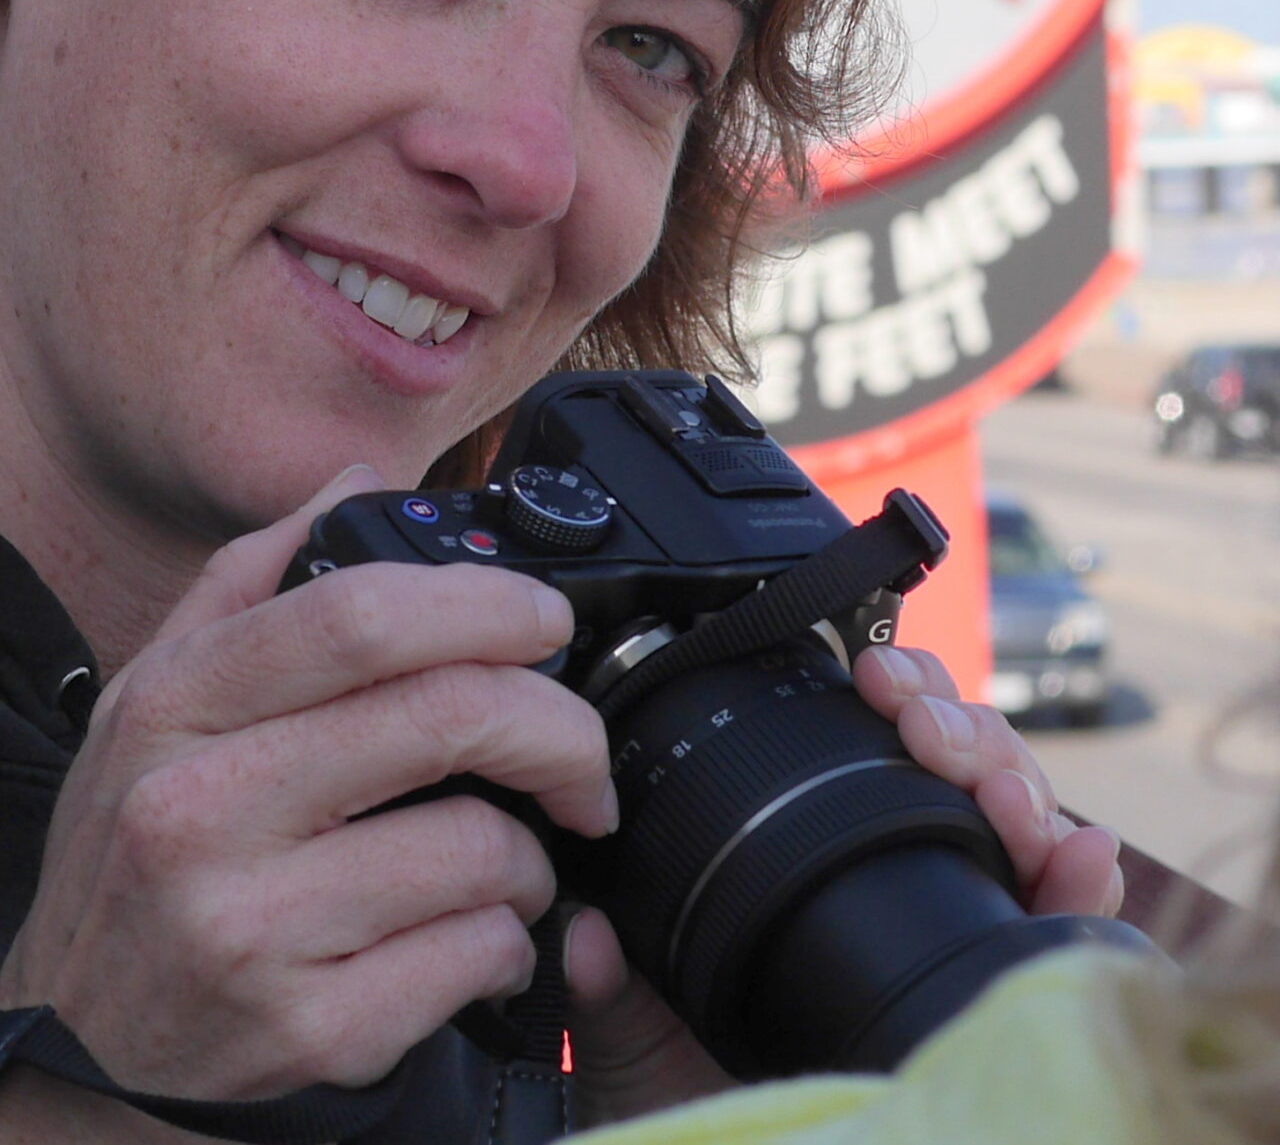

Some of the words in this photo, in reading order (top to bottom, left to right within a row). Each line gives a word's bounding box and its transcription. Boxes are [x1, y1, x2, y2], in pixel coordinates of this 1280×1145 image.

[890, 114, 1080, 293] MEET
[814, 268, 992, 409] FEET
[868, 619, 893, 643] G
[671, 739, 693, 759] 18
[711, 708, 735, 729] 25
